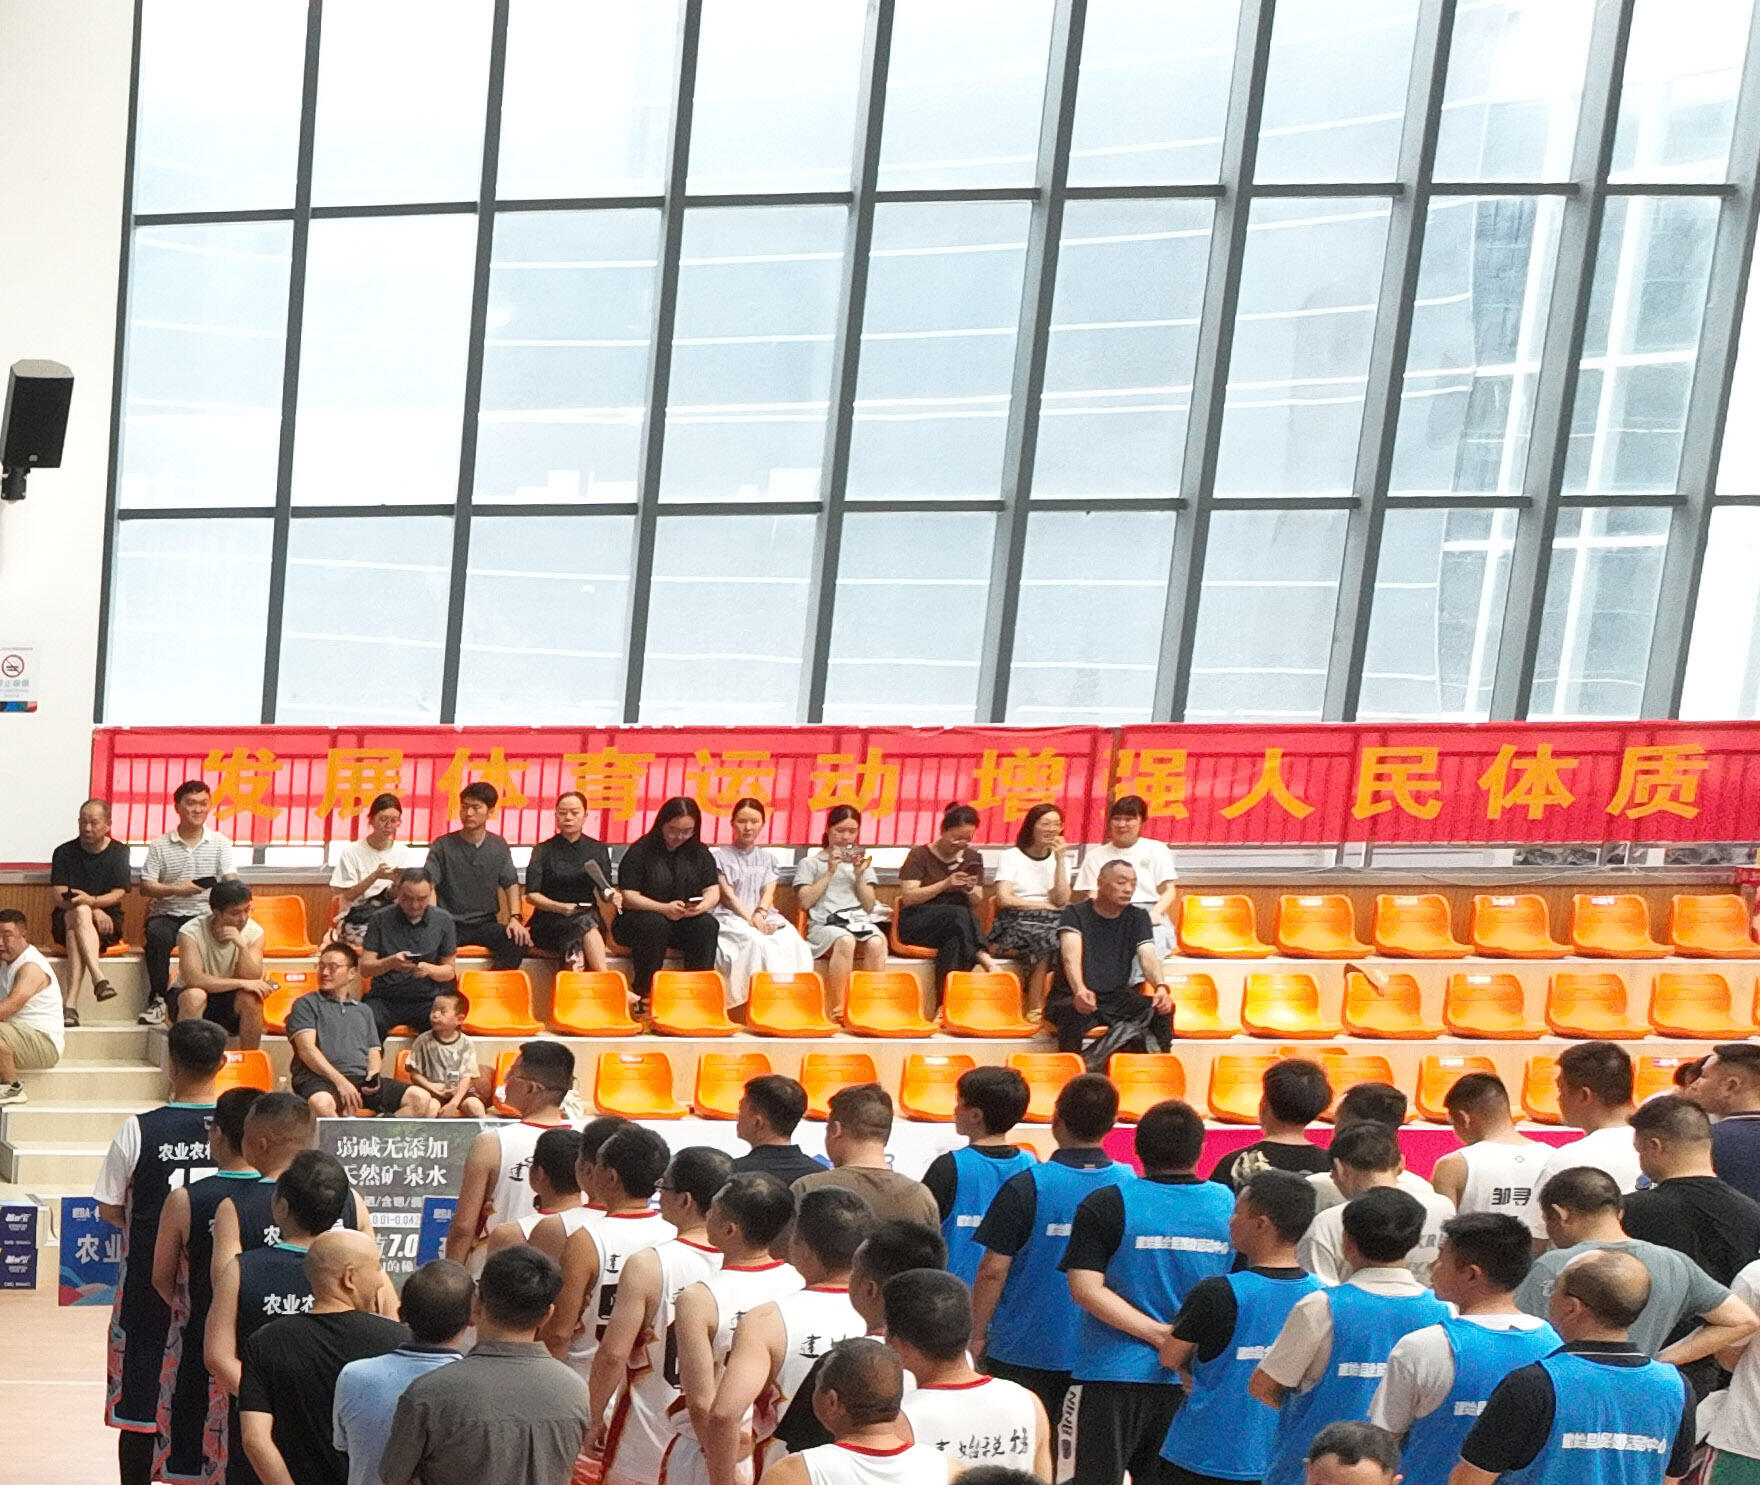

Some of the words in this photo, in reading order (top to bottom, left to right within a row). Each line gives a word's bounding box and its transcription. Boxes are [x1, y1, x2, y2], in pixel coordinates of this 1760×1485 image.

[336, 1135, 449, 1160] 弱碱无添加
